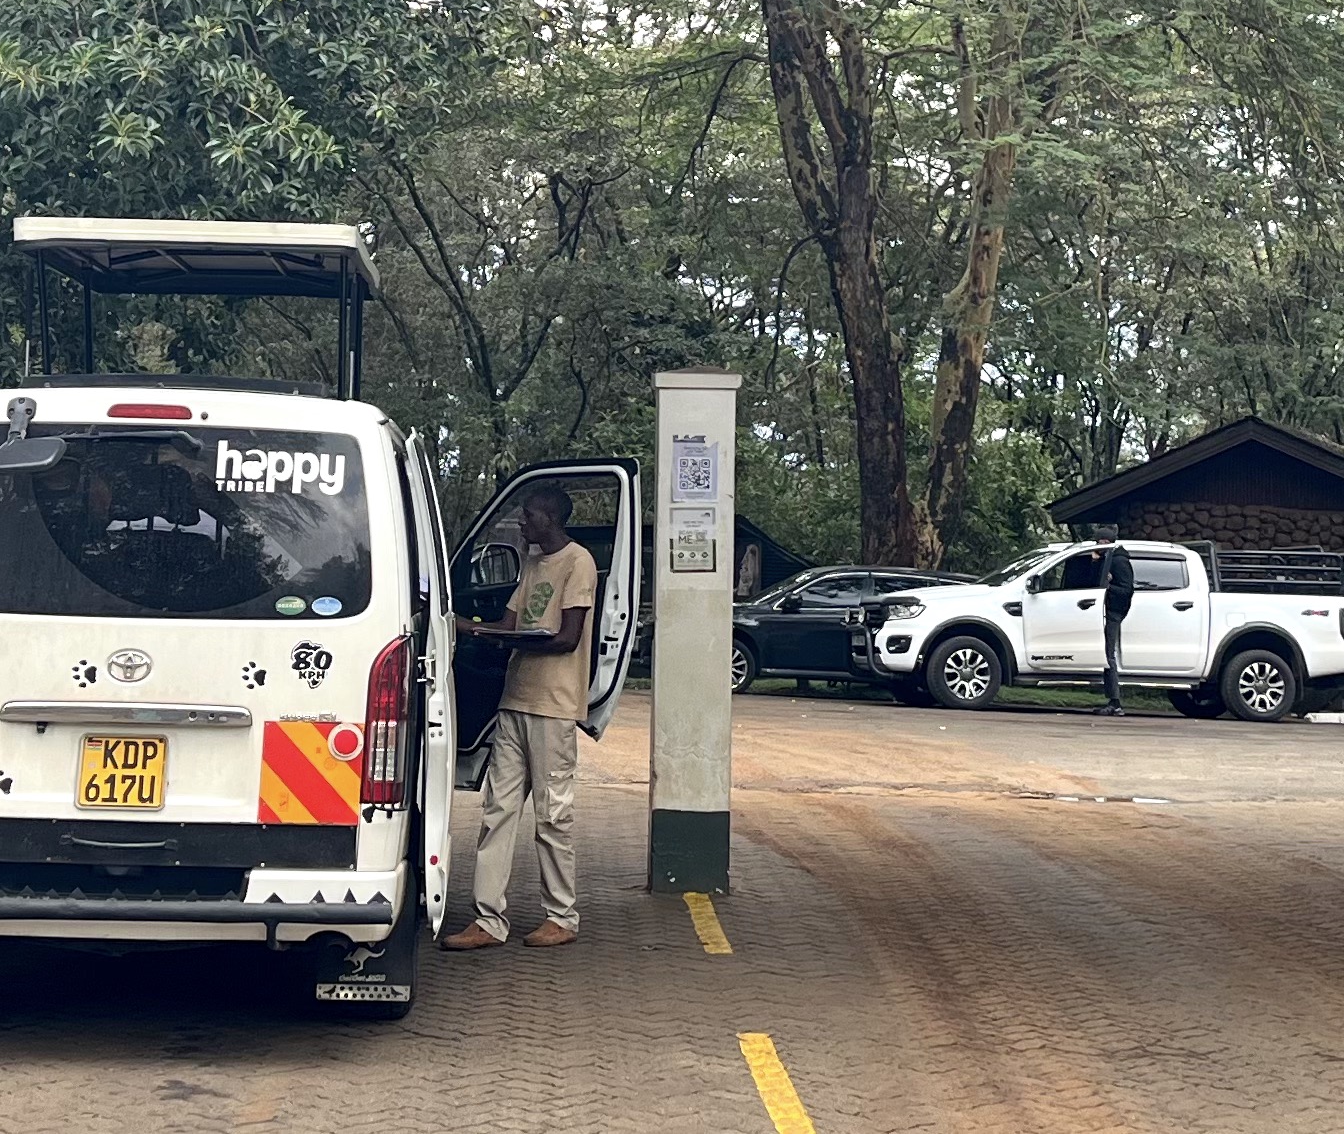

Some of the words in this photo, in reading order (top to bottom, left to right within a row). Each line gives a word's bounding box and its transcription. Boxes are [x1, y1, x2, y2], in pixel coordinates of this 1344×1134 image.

[215, 439, 346, 496] happy
[215, 480, 265, 493] TRIBE
[678, 535, 693, 544] ME
[292, 651, 333, 670] 80
[298, 670, 325, 680] KPH
[103, 739, 159, 770] KDP
[85, 774, 156, 804] 617U
